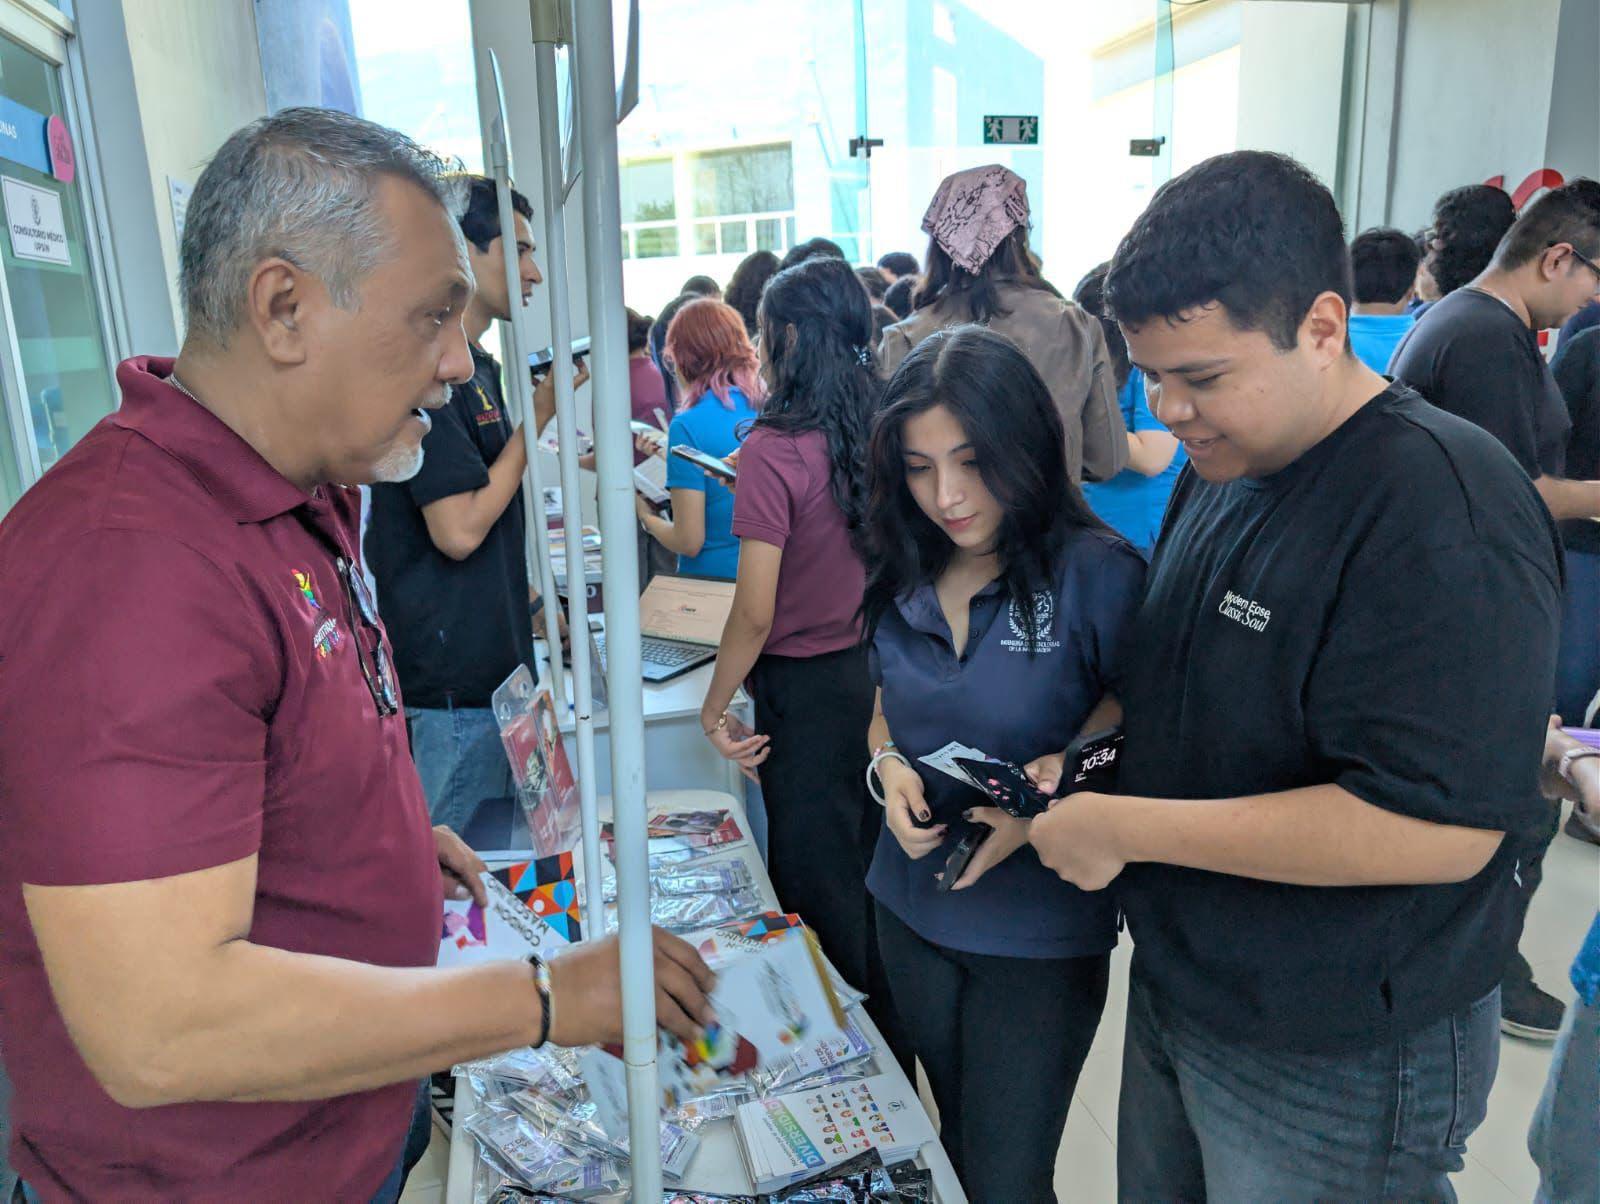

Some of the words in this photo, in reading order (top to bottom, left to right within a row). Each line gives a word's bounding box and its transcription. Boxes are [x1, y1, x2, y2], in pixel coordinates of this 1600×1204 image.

[13, 223, 46, 240] CONSULTORIO
[1082, 748, 1116, 772] 10:34
[765, 1097, 820, 1167] DIVERSIDAD
